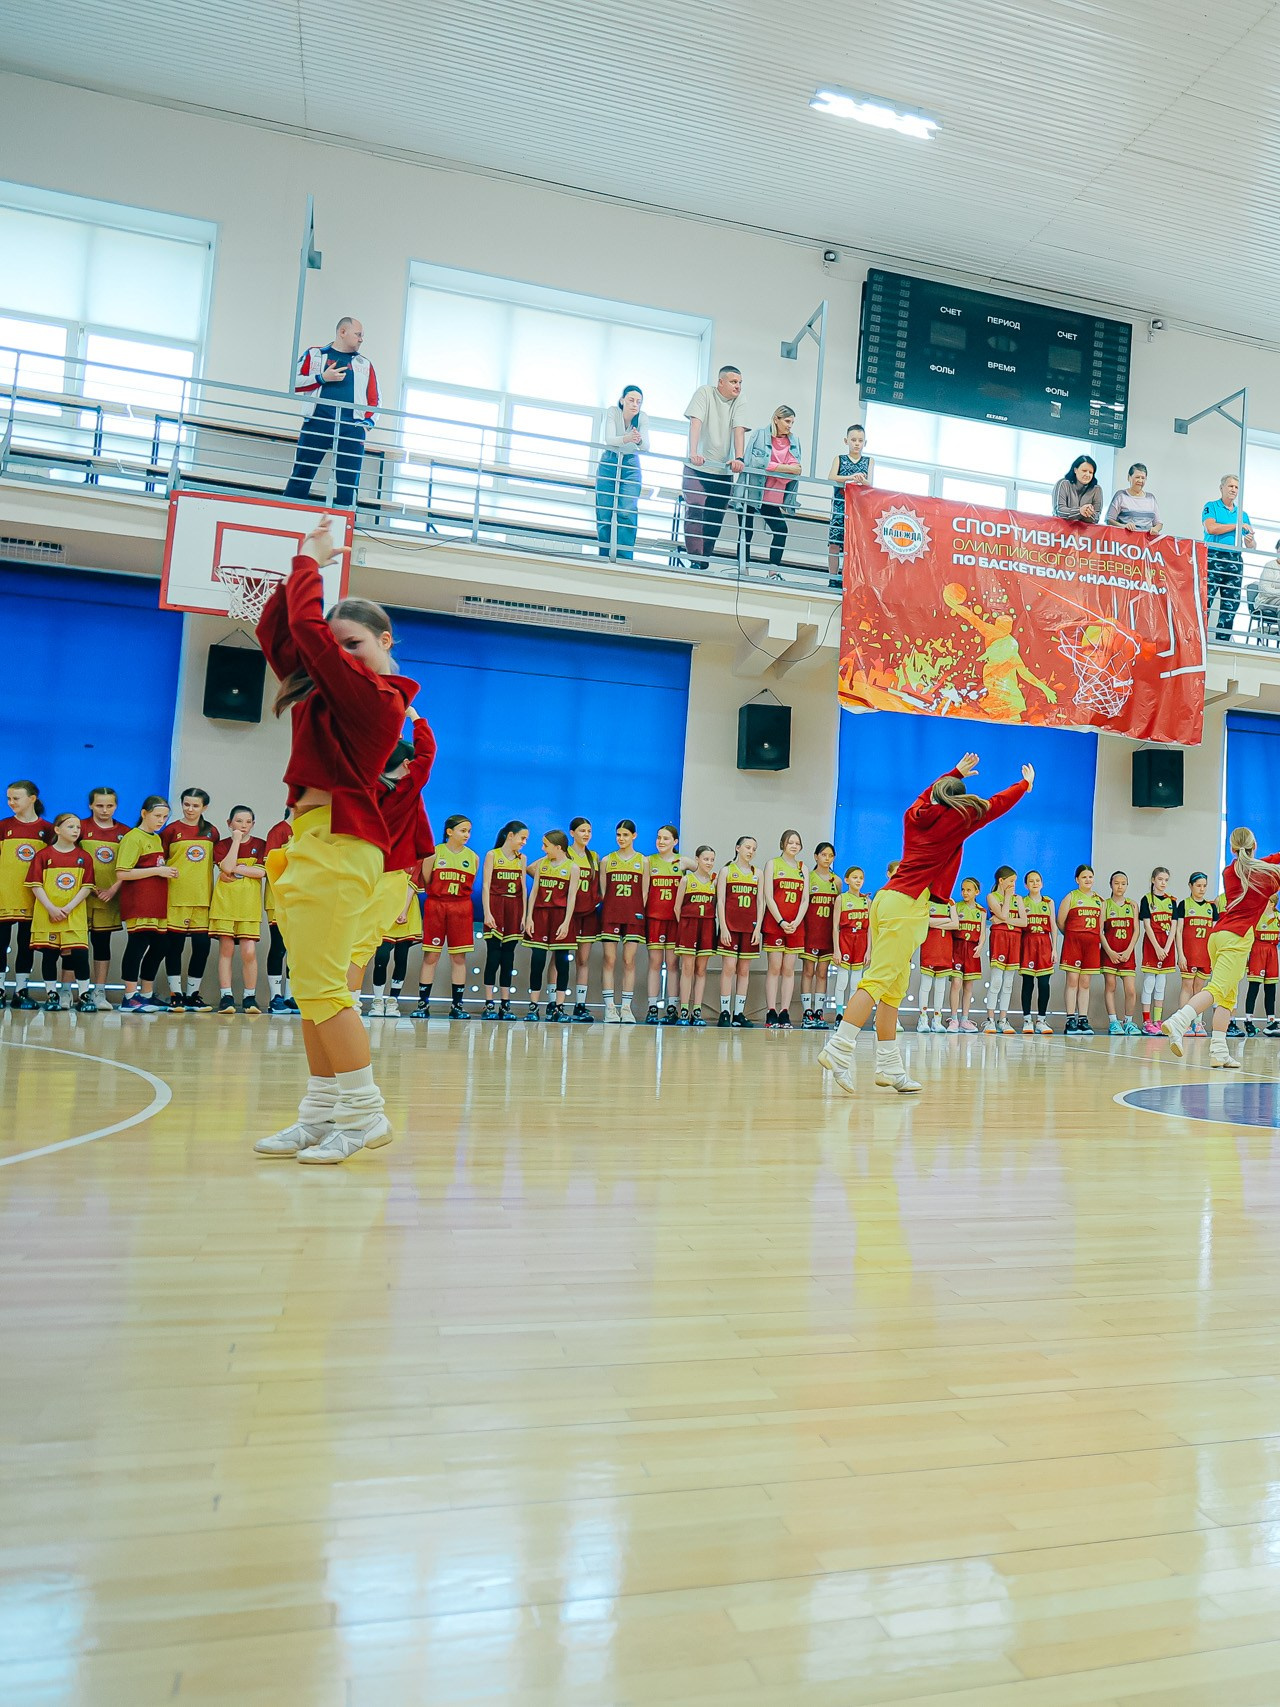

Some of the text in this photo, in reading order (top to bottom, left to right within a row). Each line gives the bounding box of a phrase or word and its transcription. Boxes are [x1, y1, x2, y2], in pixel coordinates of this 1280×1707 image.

[939, 306, 962, 317] СЧЕТ
[987, 316, 1021, 331] ПЕРИОД
[1057, 330, 1078, 341] СЧЕТ
[929, 364, 955, 375] ФОЛЫ
[987, 361, 1016, 373] ВРЕМЯ
[1045, 386, 1069, 397] ФОЛЫ
[952, 517, 1092, 553] СПОРТИВНАЯ
[1096, 539, 1165, 567] ШКОЛА
[953, 538, 1076, 567] ОЛИМПИЙСКОГО
[1079, 558, 1142, 576] РЕЗЕРВА
[952, 553, 1167, 595] ПО БАСКЕТБОЛУ «НАДЕЖДА»
[460, 874, 466, 883] 5
[497, 871, 519, 880] СШОР
[580, 869, 590, 878] ОР
[611, 873, 633, 882] СШОР
[507, 882, 516, 894] 3
[558, 881, 565, 890] 5
[652, 878, 680, 887] СШОР 5
[779, 880, 799, 890] СШОР
[615, 884, 632, 897] 25
[659, 888, 673, 900] 75
[731, 885, 758, 895] СШОР 5
[544, 890, 553, 903] 7
[737, 895, 751, 908] 10
[784, 891, 797, 904] 79
[811, 895, 832, 904] СШОР
[698, 904, 705, 916] 1
[816, 905, 830, 918] 40
[1043, 917, 1048, 925] 5
[1085, 917, 1097, 929] 29
[1115, 928, 1127, 940] 43
[1195, 927, 1207, 938] 27
